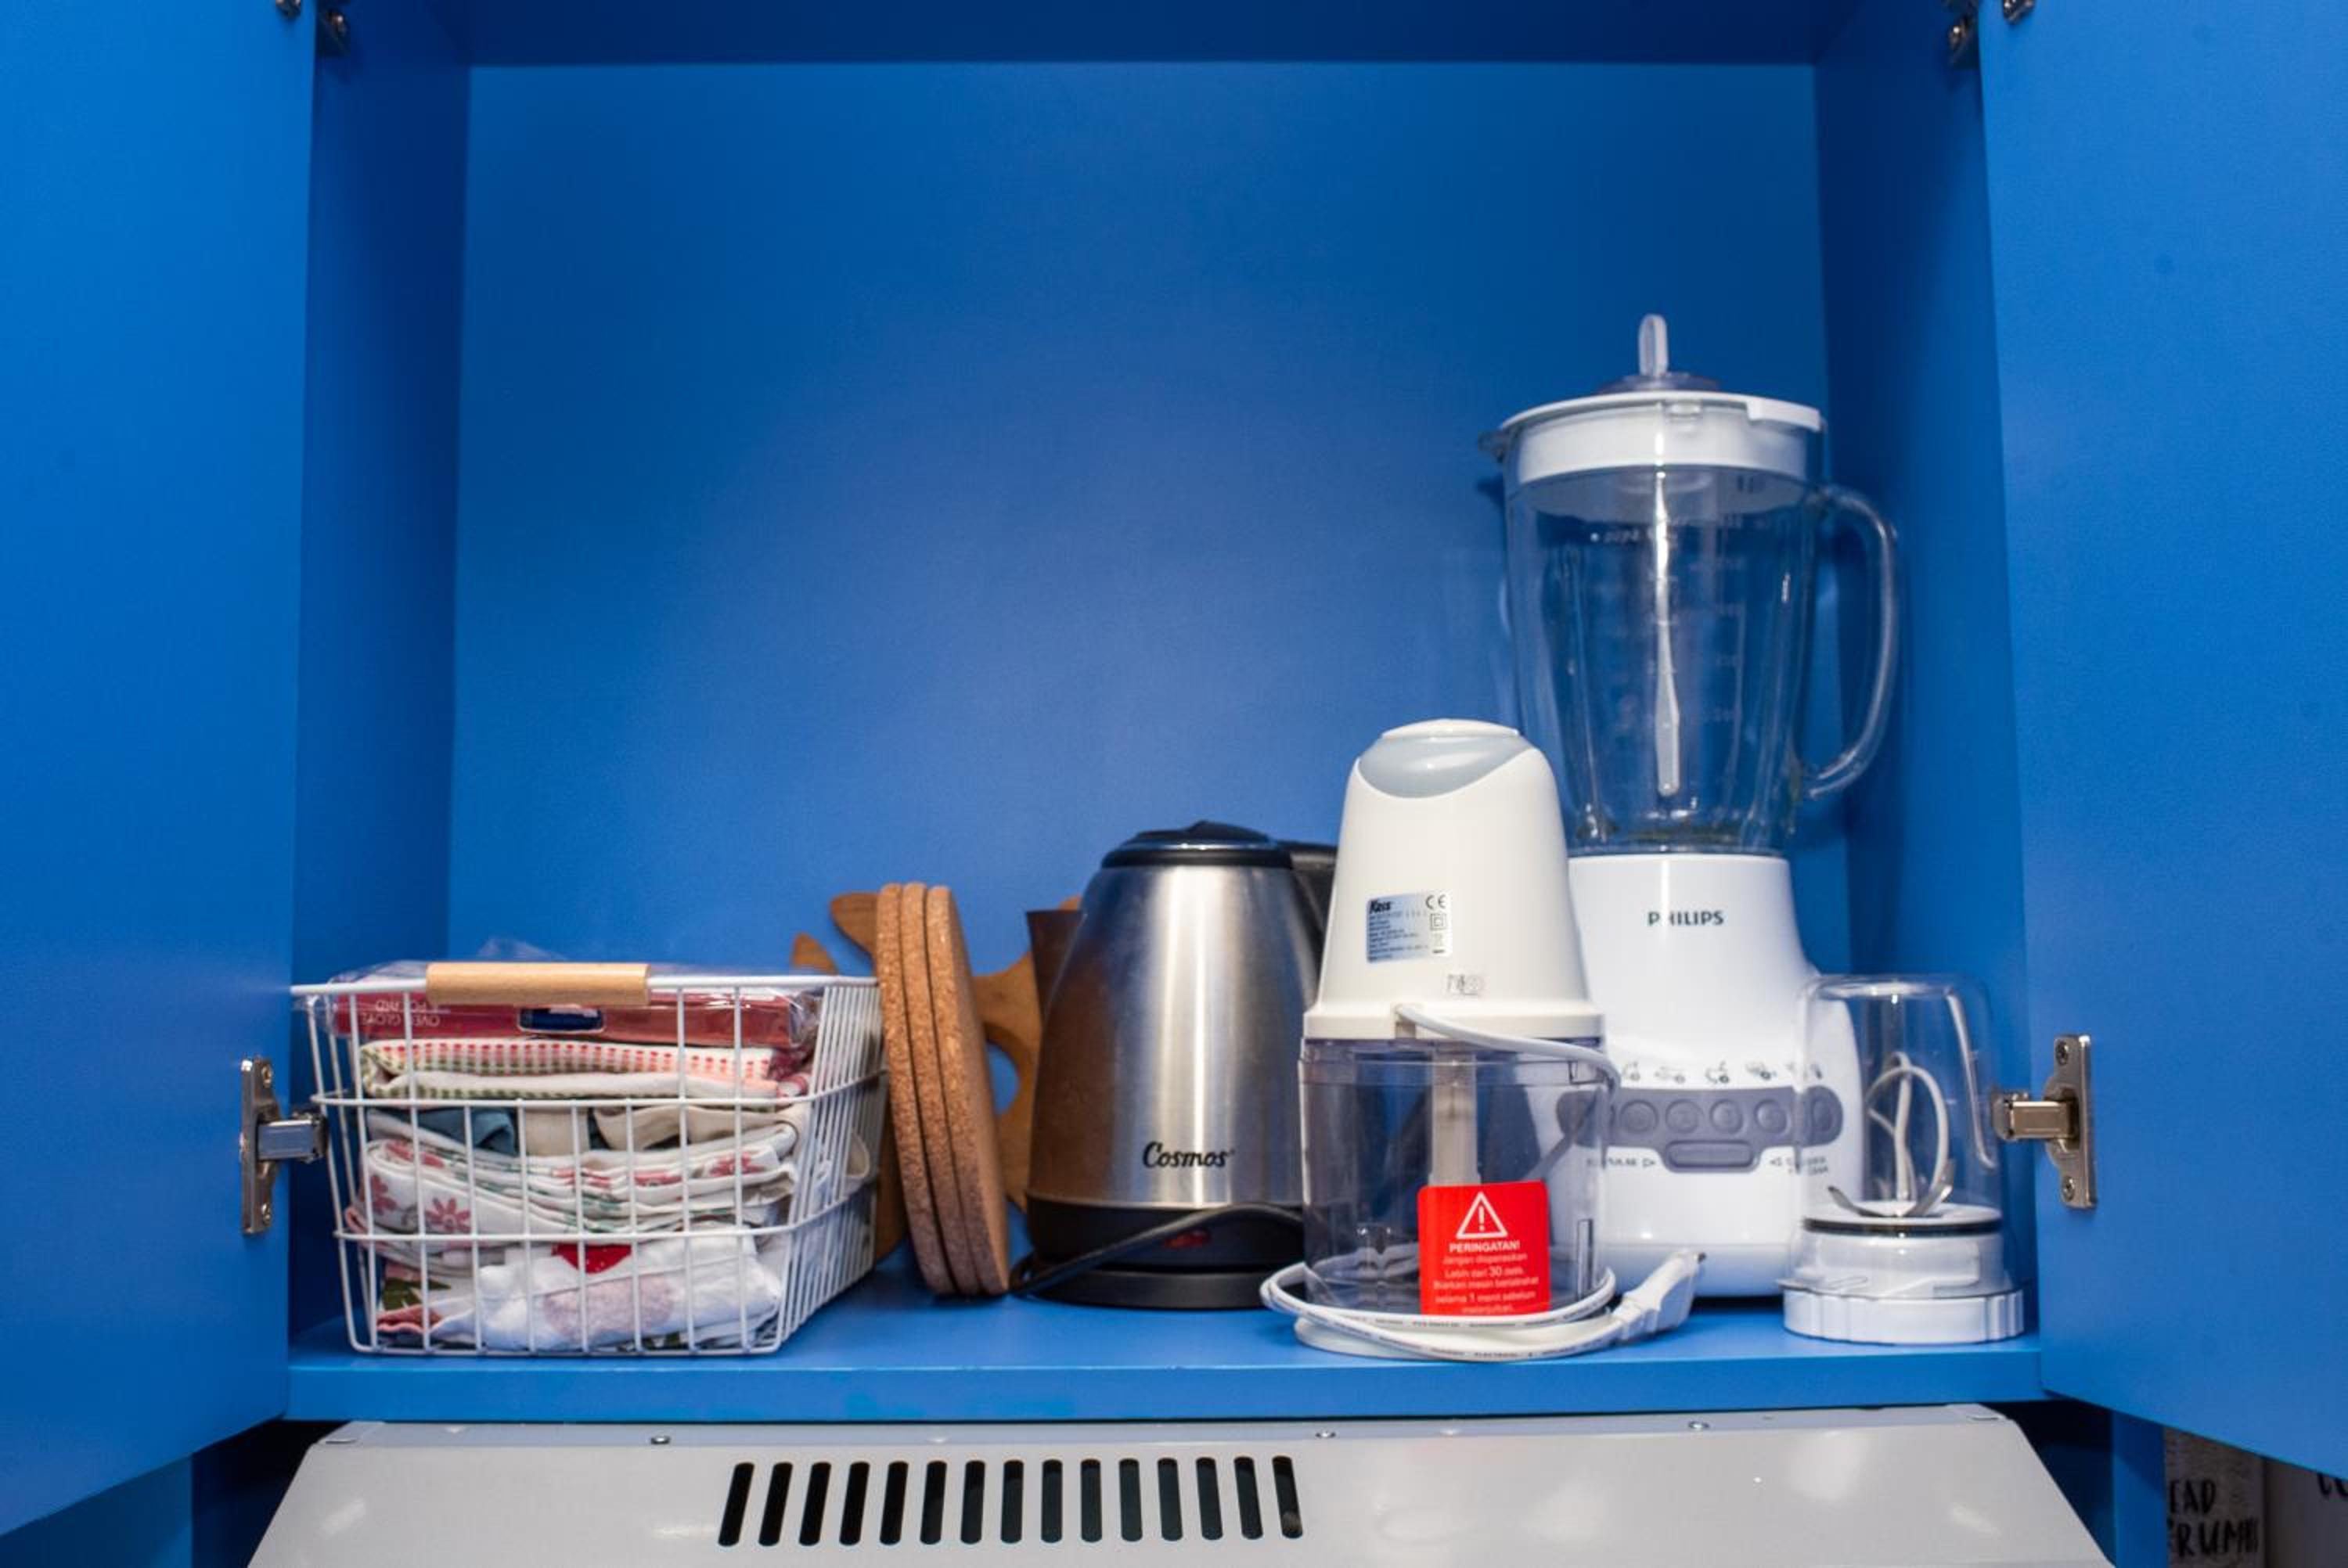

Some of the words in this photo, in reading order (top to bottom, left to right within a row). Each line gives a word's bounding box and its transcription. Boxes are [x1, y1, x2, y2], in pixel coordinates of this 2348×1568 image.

[1648, 910, 1724, 926] PHILIPS
[409, 1013, 441, 1027] OVE
[1143, 1141, 1228, 1168] Cosmos
[1449, 1240, 1521, 1253] PERINGATAN!
[1489, 1265, 1502, 1277] 30
[2169, 1480, 2217, 1515] EAD
